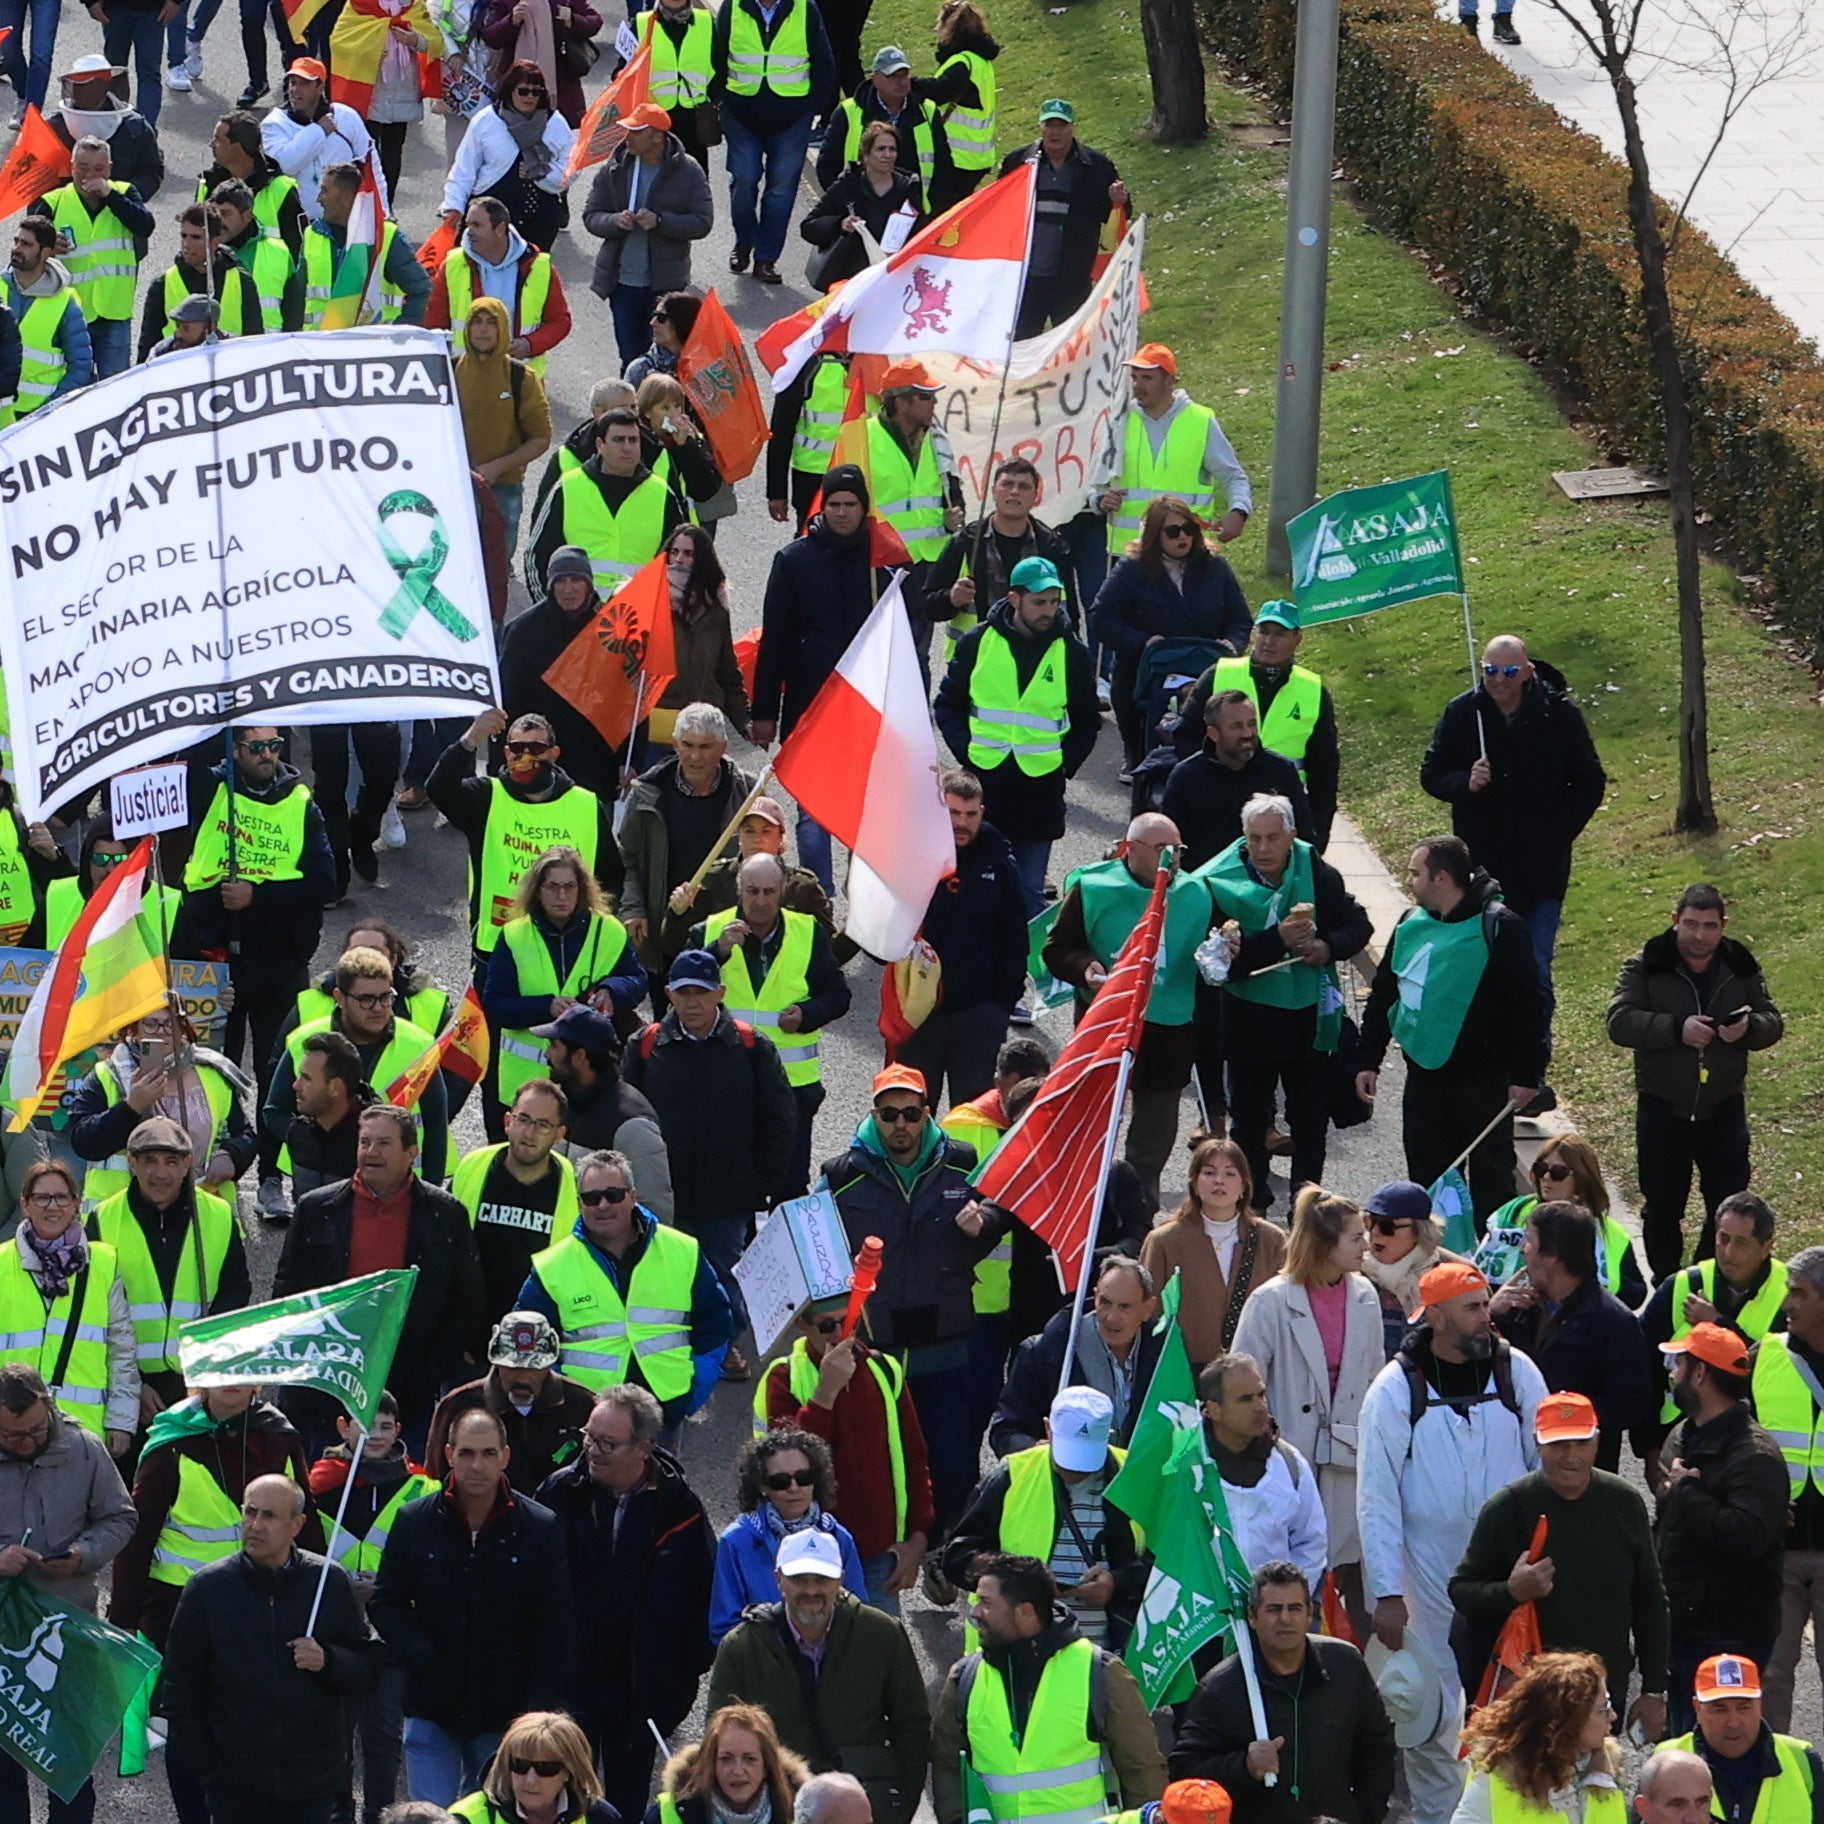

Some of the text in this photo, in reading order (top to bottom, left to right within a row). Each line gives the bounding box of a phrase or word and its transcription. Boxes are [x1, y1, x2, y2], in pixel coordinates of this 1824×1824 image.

[88, 359, 450, 473] AGRICULTURA,
[11, 435, 415, 579] NO HAY FUTURO.
[1347, 502, 1450, 546] ASAJA
[23, 619, 55, 643] EL
[156, 542, 198, 570] DE
[208, 534, 245, 560] LA
[201, 562, 356, 612] AGRÍCOLA
[68, 656, 151, 710] APOYO
[162, 647, 183, 670] A
[192, 615, 353, 664] NUESTROS
[42, 663, 491, 792] AGRICULTORES Y GANADEROS
[114, 773, 184, 827] Justicia!
[257, 835, 291, 854] SERÁ
[795, 1194, 822, 1216] NO
[1141, 1591, 1215, 1688] ASAJA
[5, 1714, 57, 1773] REAL
